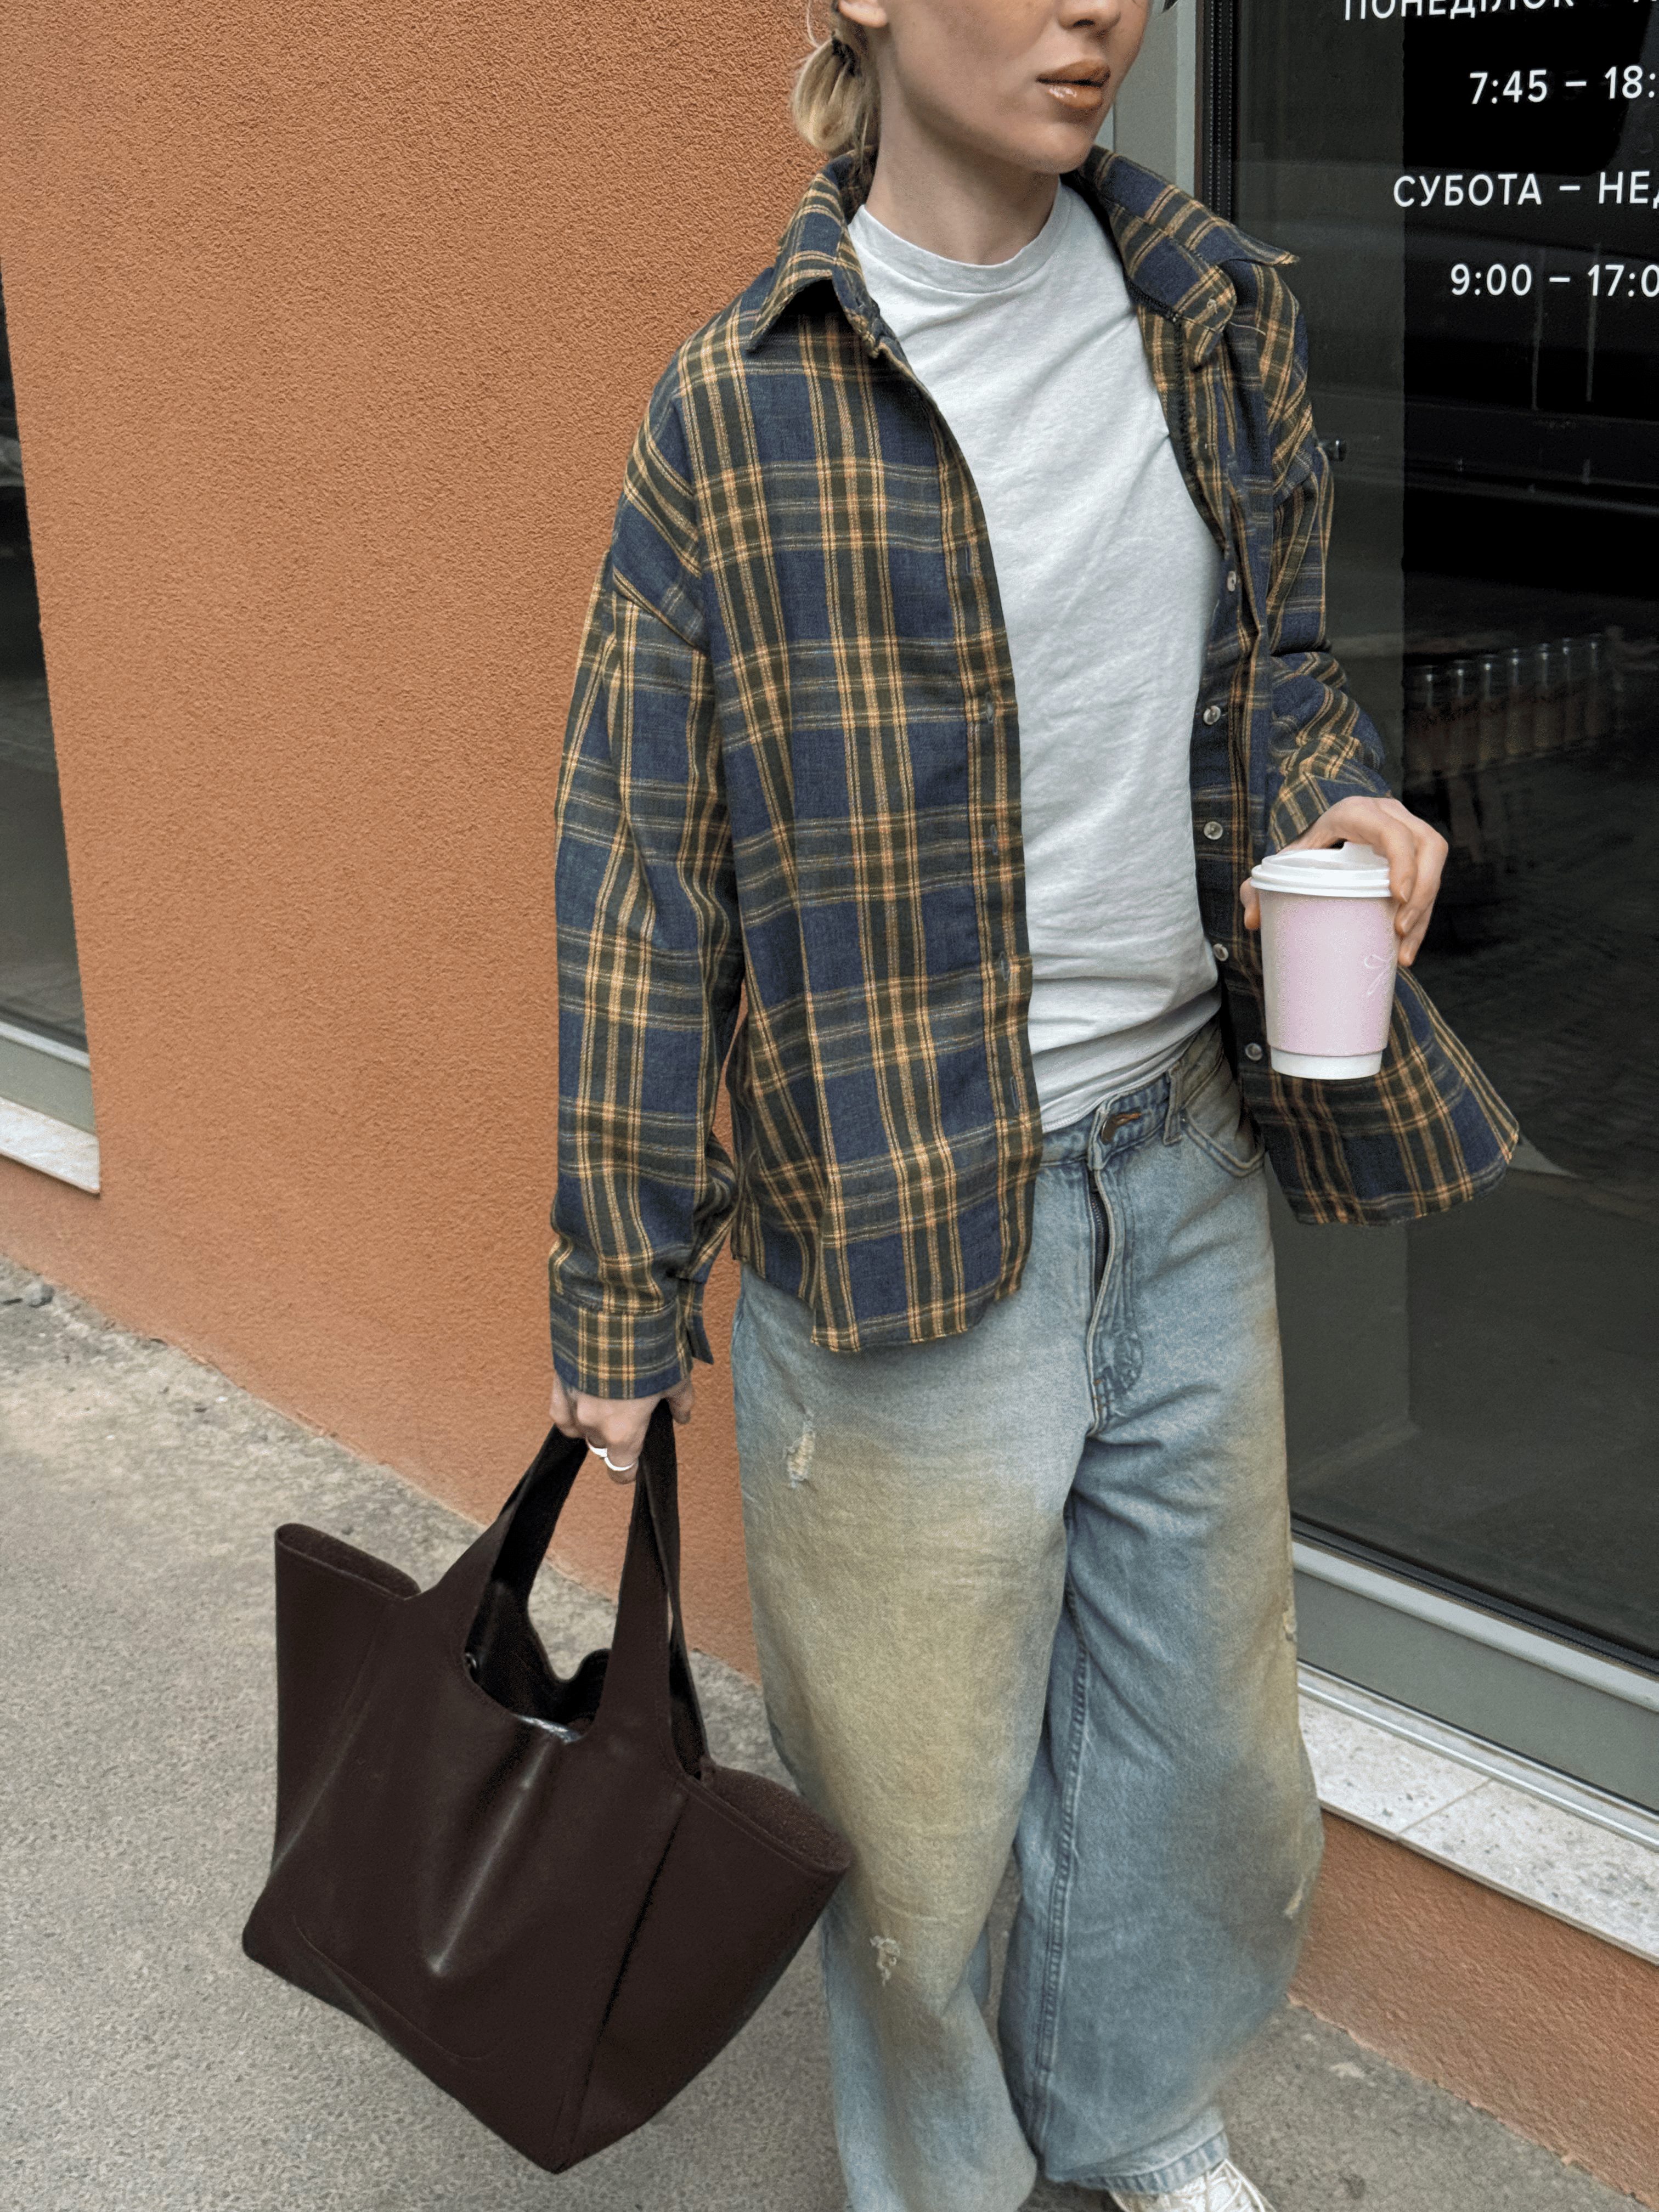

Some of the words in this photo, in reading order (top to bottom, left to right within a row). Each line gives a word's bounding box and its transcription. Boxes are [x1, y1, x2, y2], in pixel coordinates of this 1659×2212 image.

[1470, 69, 1547, 104] 7:45
[1605, 65, 1656, 99] 18:
[1393, 173, 1542, 207] СУБОТА
[1598, 171, 1659, 210] НЕ
[1451, 263, 1532, 296] 9:00
[1587, 264, 1659, 297] 17:0
